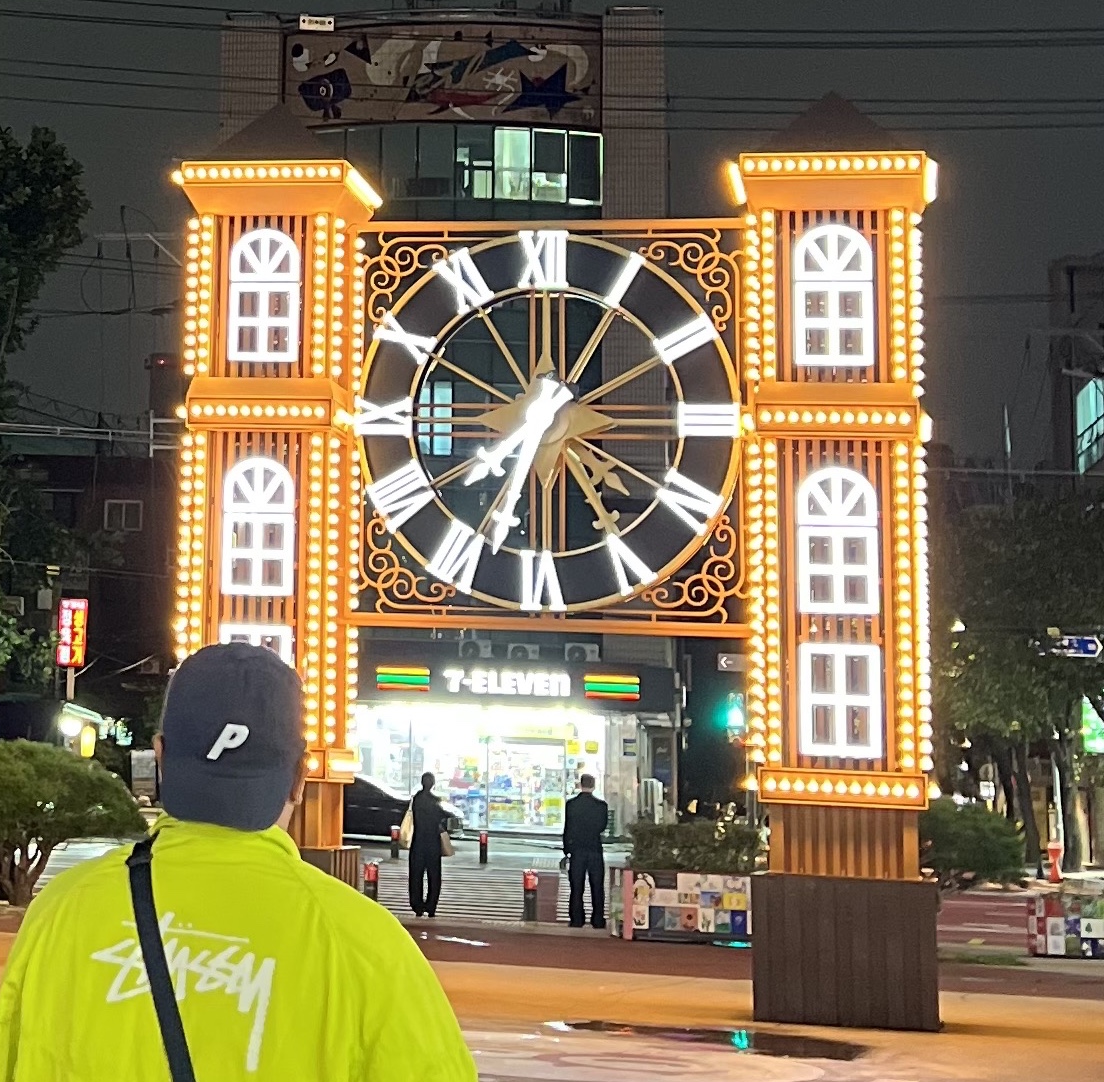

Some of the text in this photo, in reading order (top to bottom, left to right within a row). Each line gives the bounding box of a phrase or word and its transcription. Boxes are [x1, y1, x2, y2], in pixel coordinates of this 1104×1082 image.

[433, 247, 494, 315] XI
[518, 230, 570, 290] XII
[374, 313, 438, 364] X
[652, 313, 720, 365] II
[354, 395, 412, 438] IX
[677, 402, 740, 437] III
[366, 459, 439, 534] VIII
[656, 469, 724, 536] IV
[426, 519, 487, 595] VII
[519, 549, 567, 612] VI
[606, 533, 659, 595] V
[206, 723, 250, 761] P
